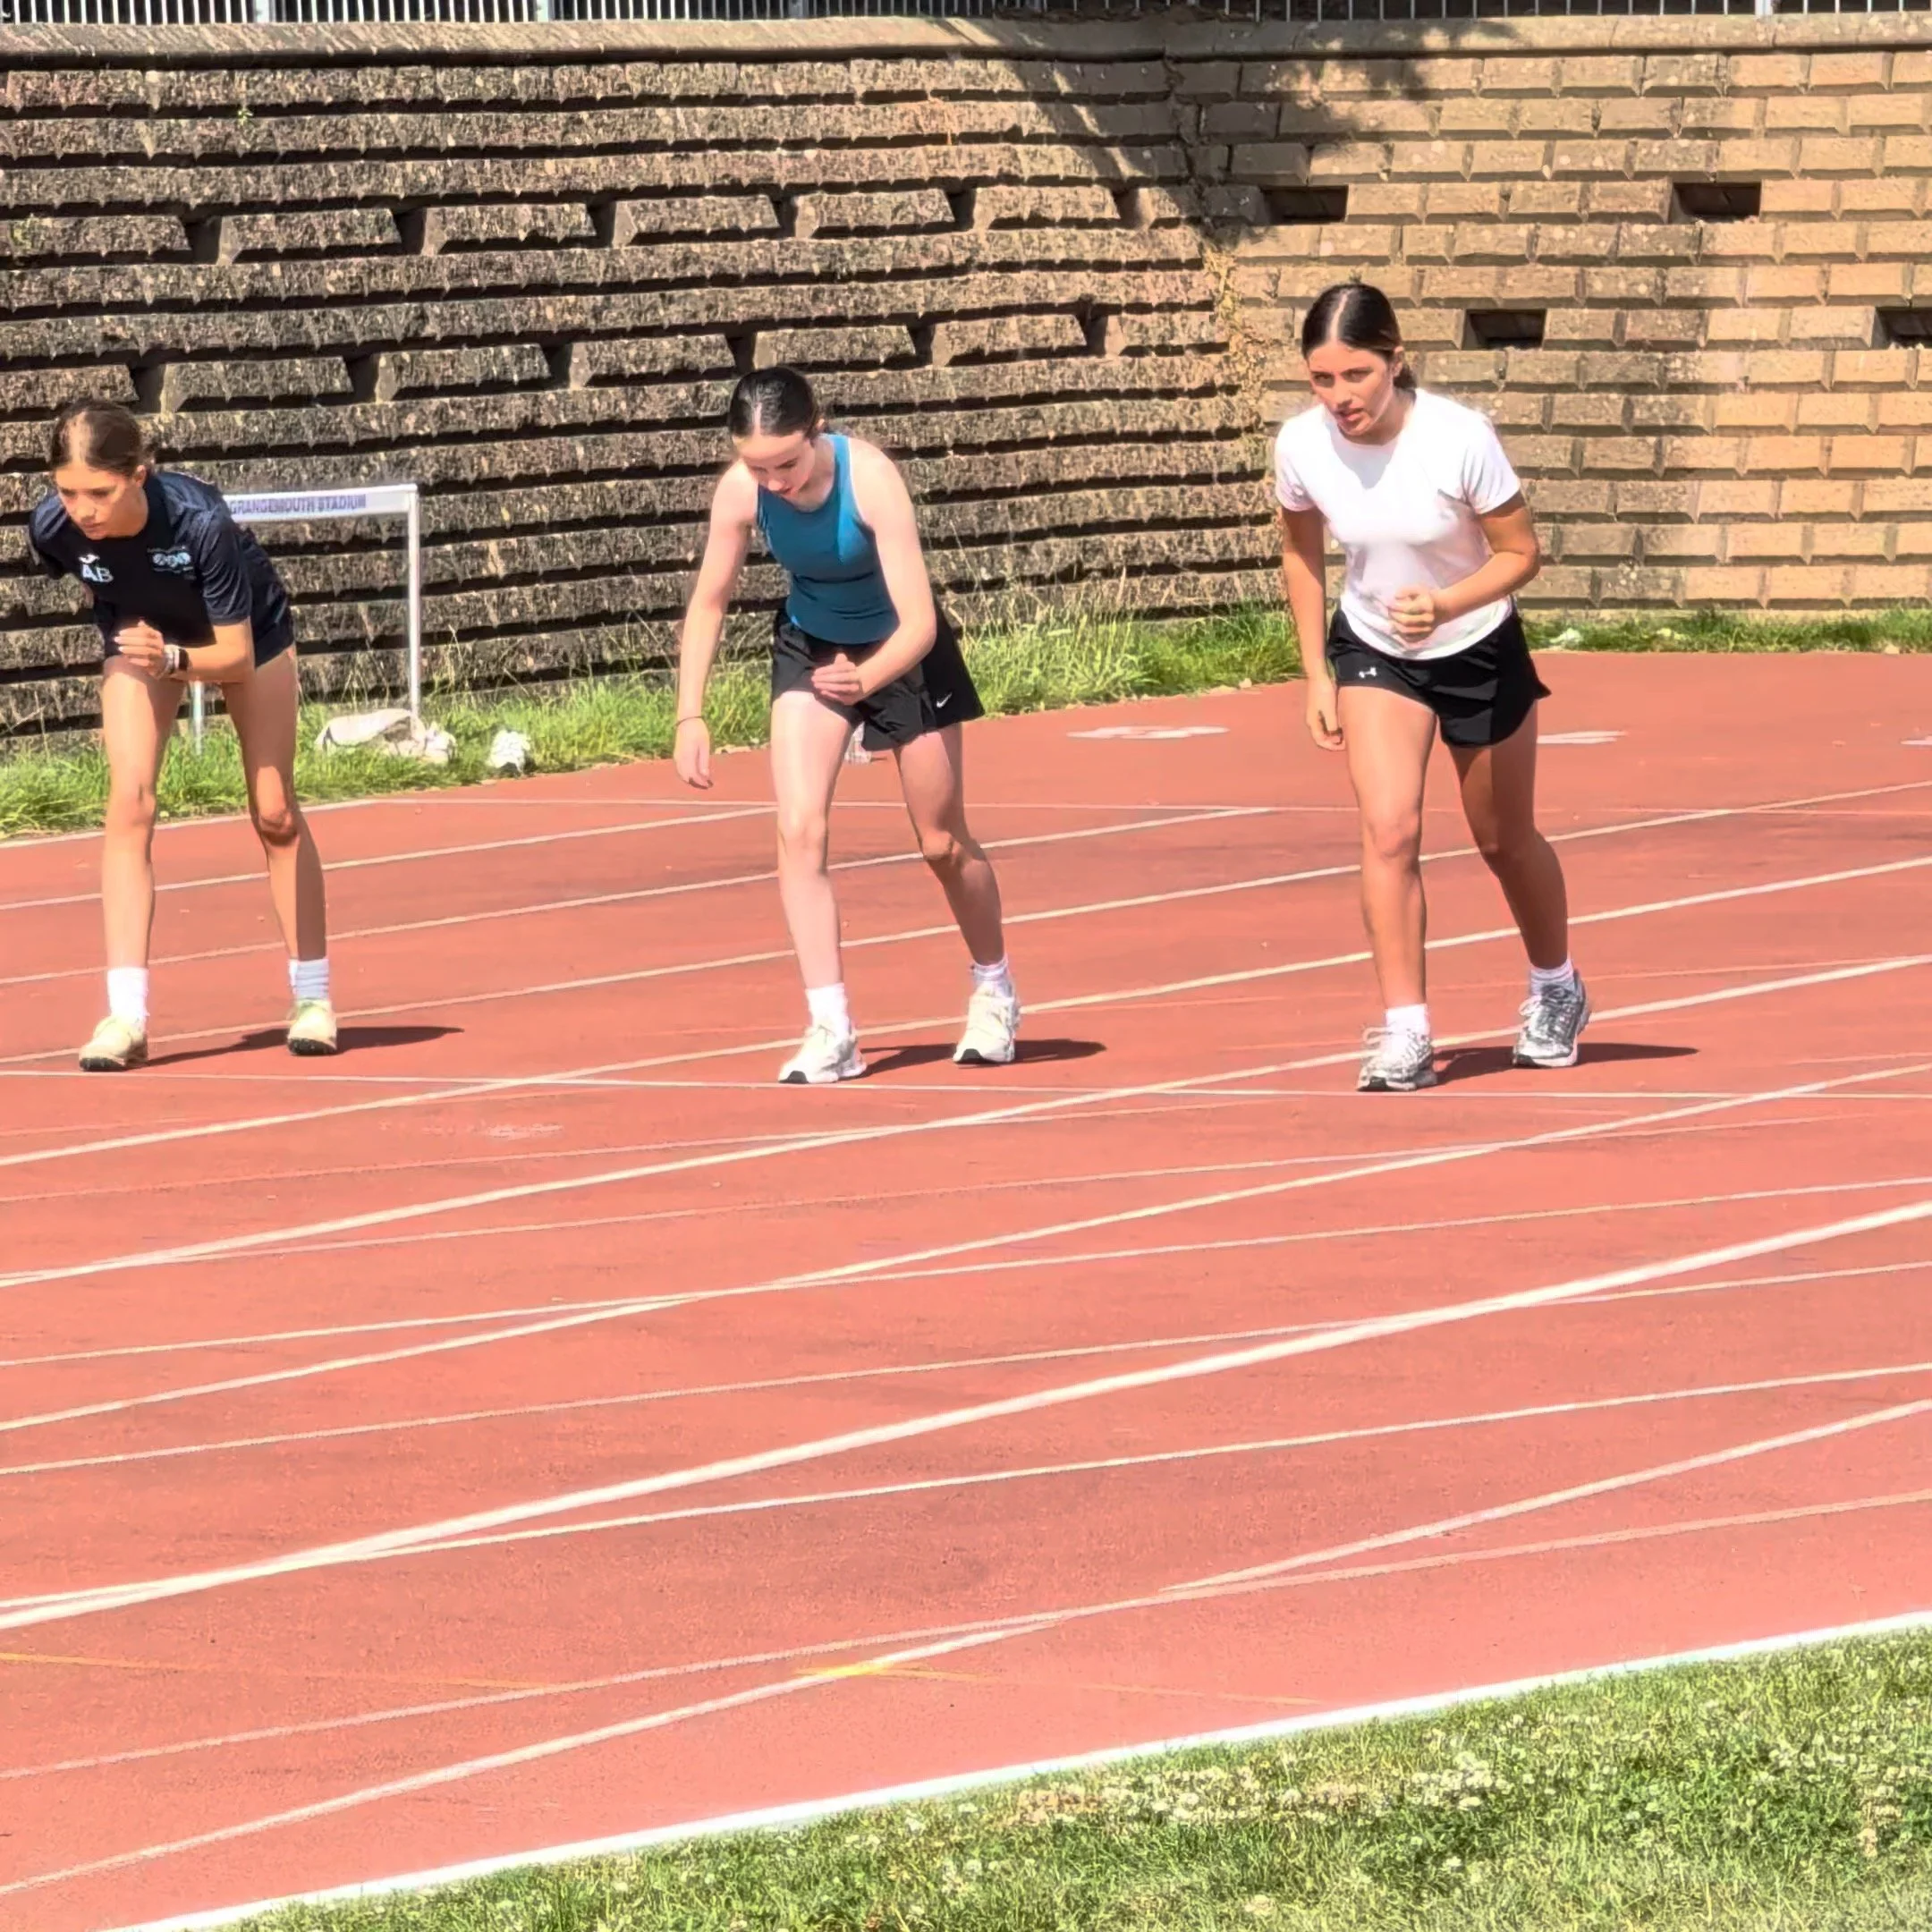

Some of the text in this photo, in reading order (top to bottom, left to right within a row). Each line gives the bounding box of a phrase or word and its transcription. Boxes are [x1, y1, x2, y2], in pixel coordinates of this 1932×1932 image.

[229, 494, 367, 514] GRANGEMOUTH STADIUM
[82, 564, 114, 582] AB
